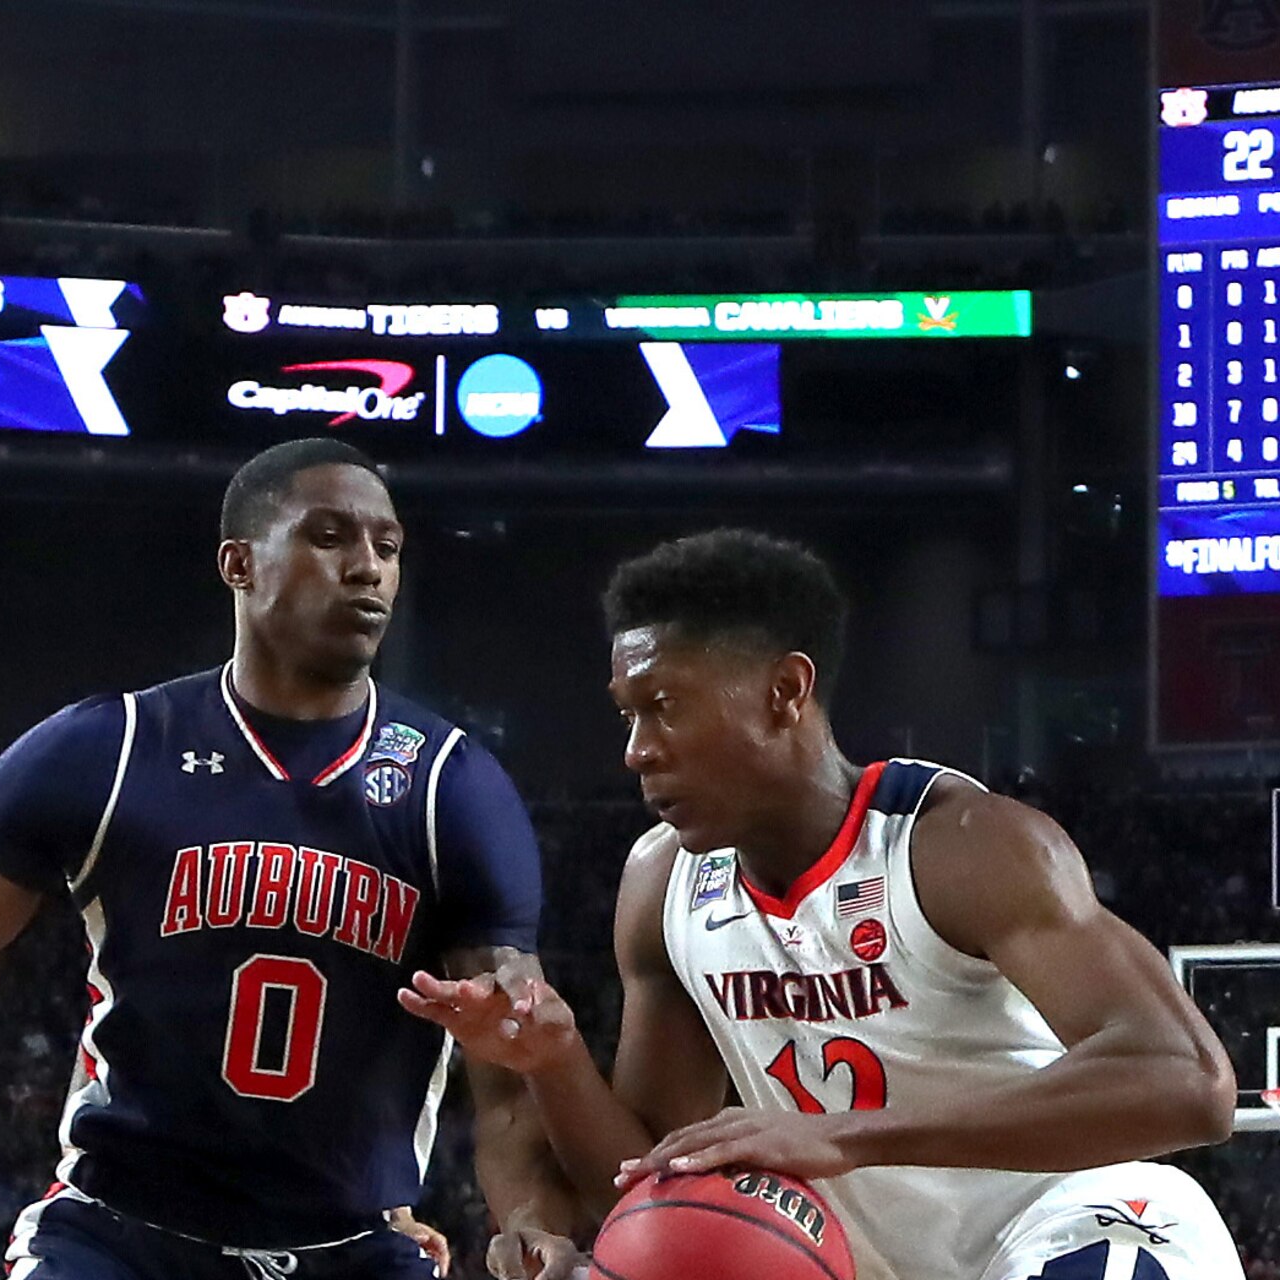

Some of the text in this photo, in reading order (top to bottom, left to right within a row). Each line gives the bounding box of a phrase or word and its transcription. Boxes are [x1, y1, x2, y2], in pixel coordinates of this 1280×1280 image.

[1223, 128, 1274, 181] 22
[1264, 280, 1276, 304] 1
[367, 304, 499, 335] TIGERS
[714, 299, 904, 332] CAVALIERS
[1178, 324, 1191, 348] 1
[1264, 319, 1276, 343] 1
[1177, 363, 1192, 387] 2
[1264, 358, 1276, 383] 1
[1228, 400, 1242, 423] 7
[1222, 480, 1235, 500] 5
[365, 766, 407, 804] SEC
[160, 841, 421, 964] AUBURN
[704, 962, 910, 1022] VIRGINIA
[221, 952, 328, 1103] 0
